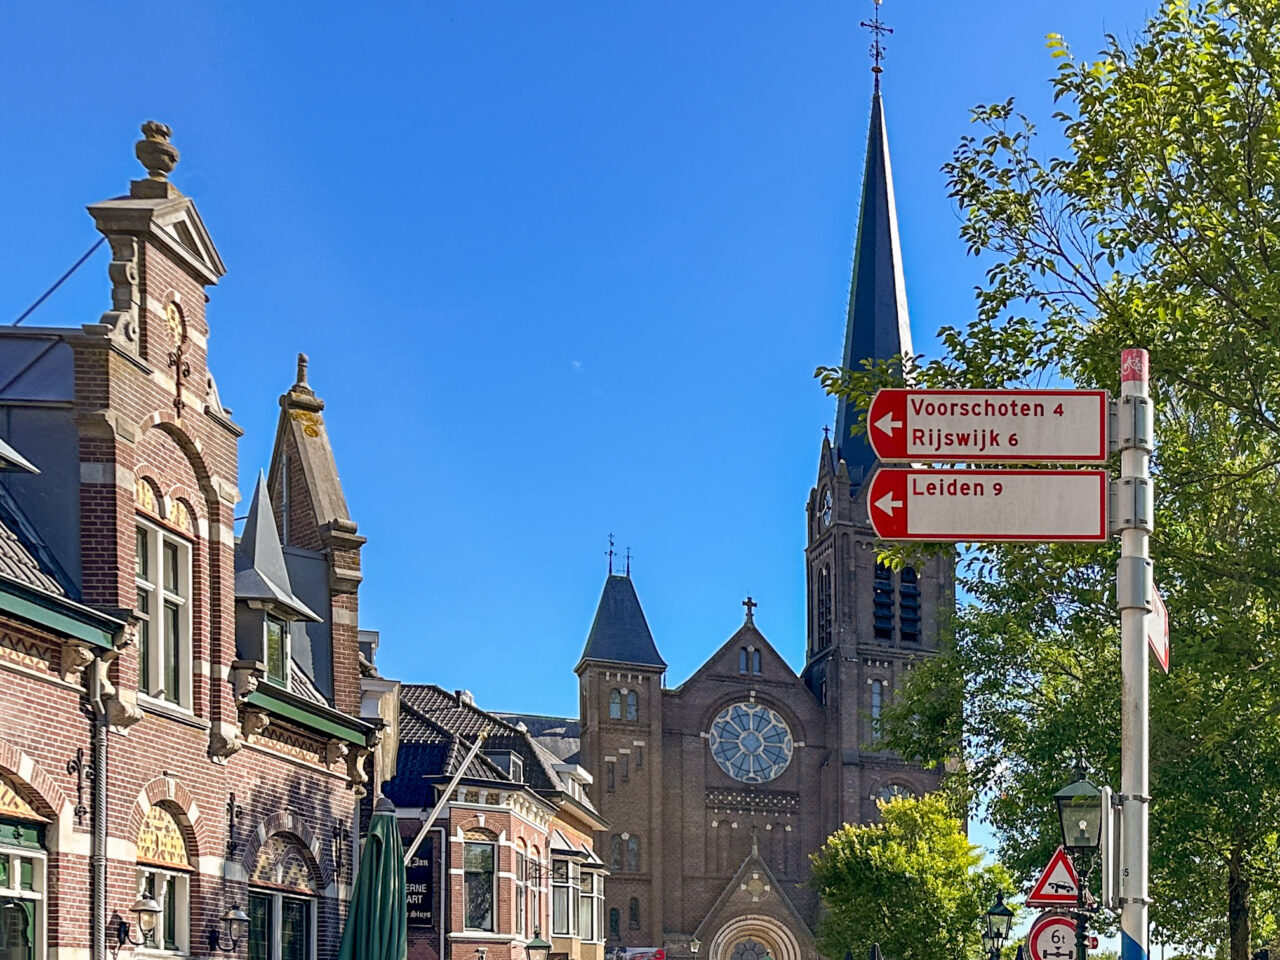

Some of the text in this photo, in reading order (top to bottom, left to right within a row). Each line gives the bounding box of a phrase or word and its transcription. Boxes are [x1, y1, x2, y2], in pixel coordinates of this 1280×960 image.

[911, 398, 1064, 417] Voorschoten 4
[912, 428, 1019, 452] Rijswijk 6
[912, 478, 1003, 496] Leiden 9
